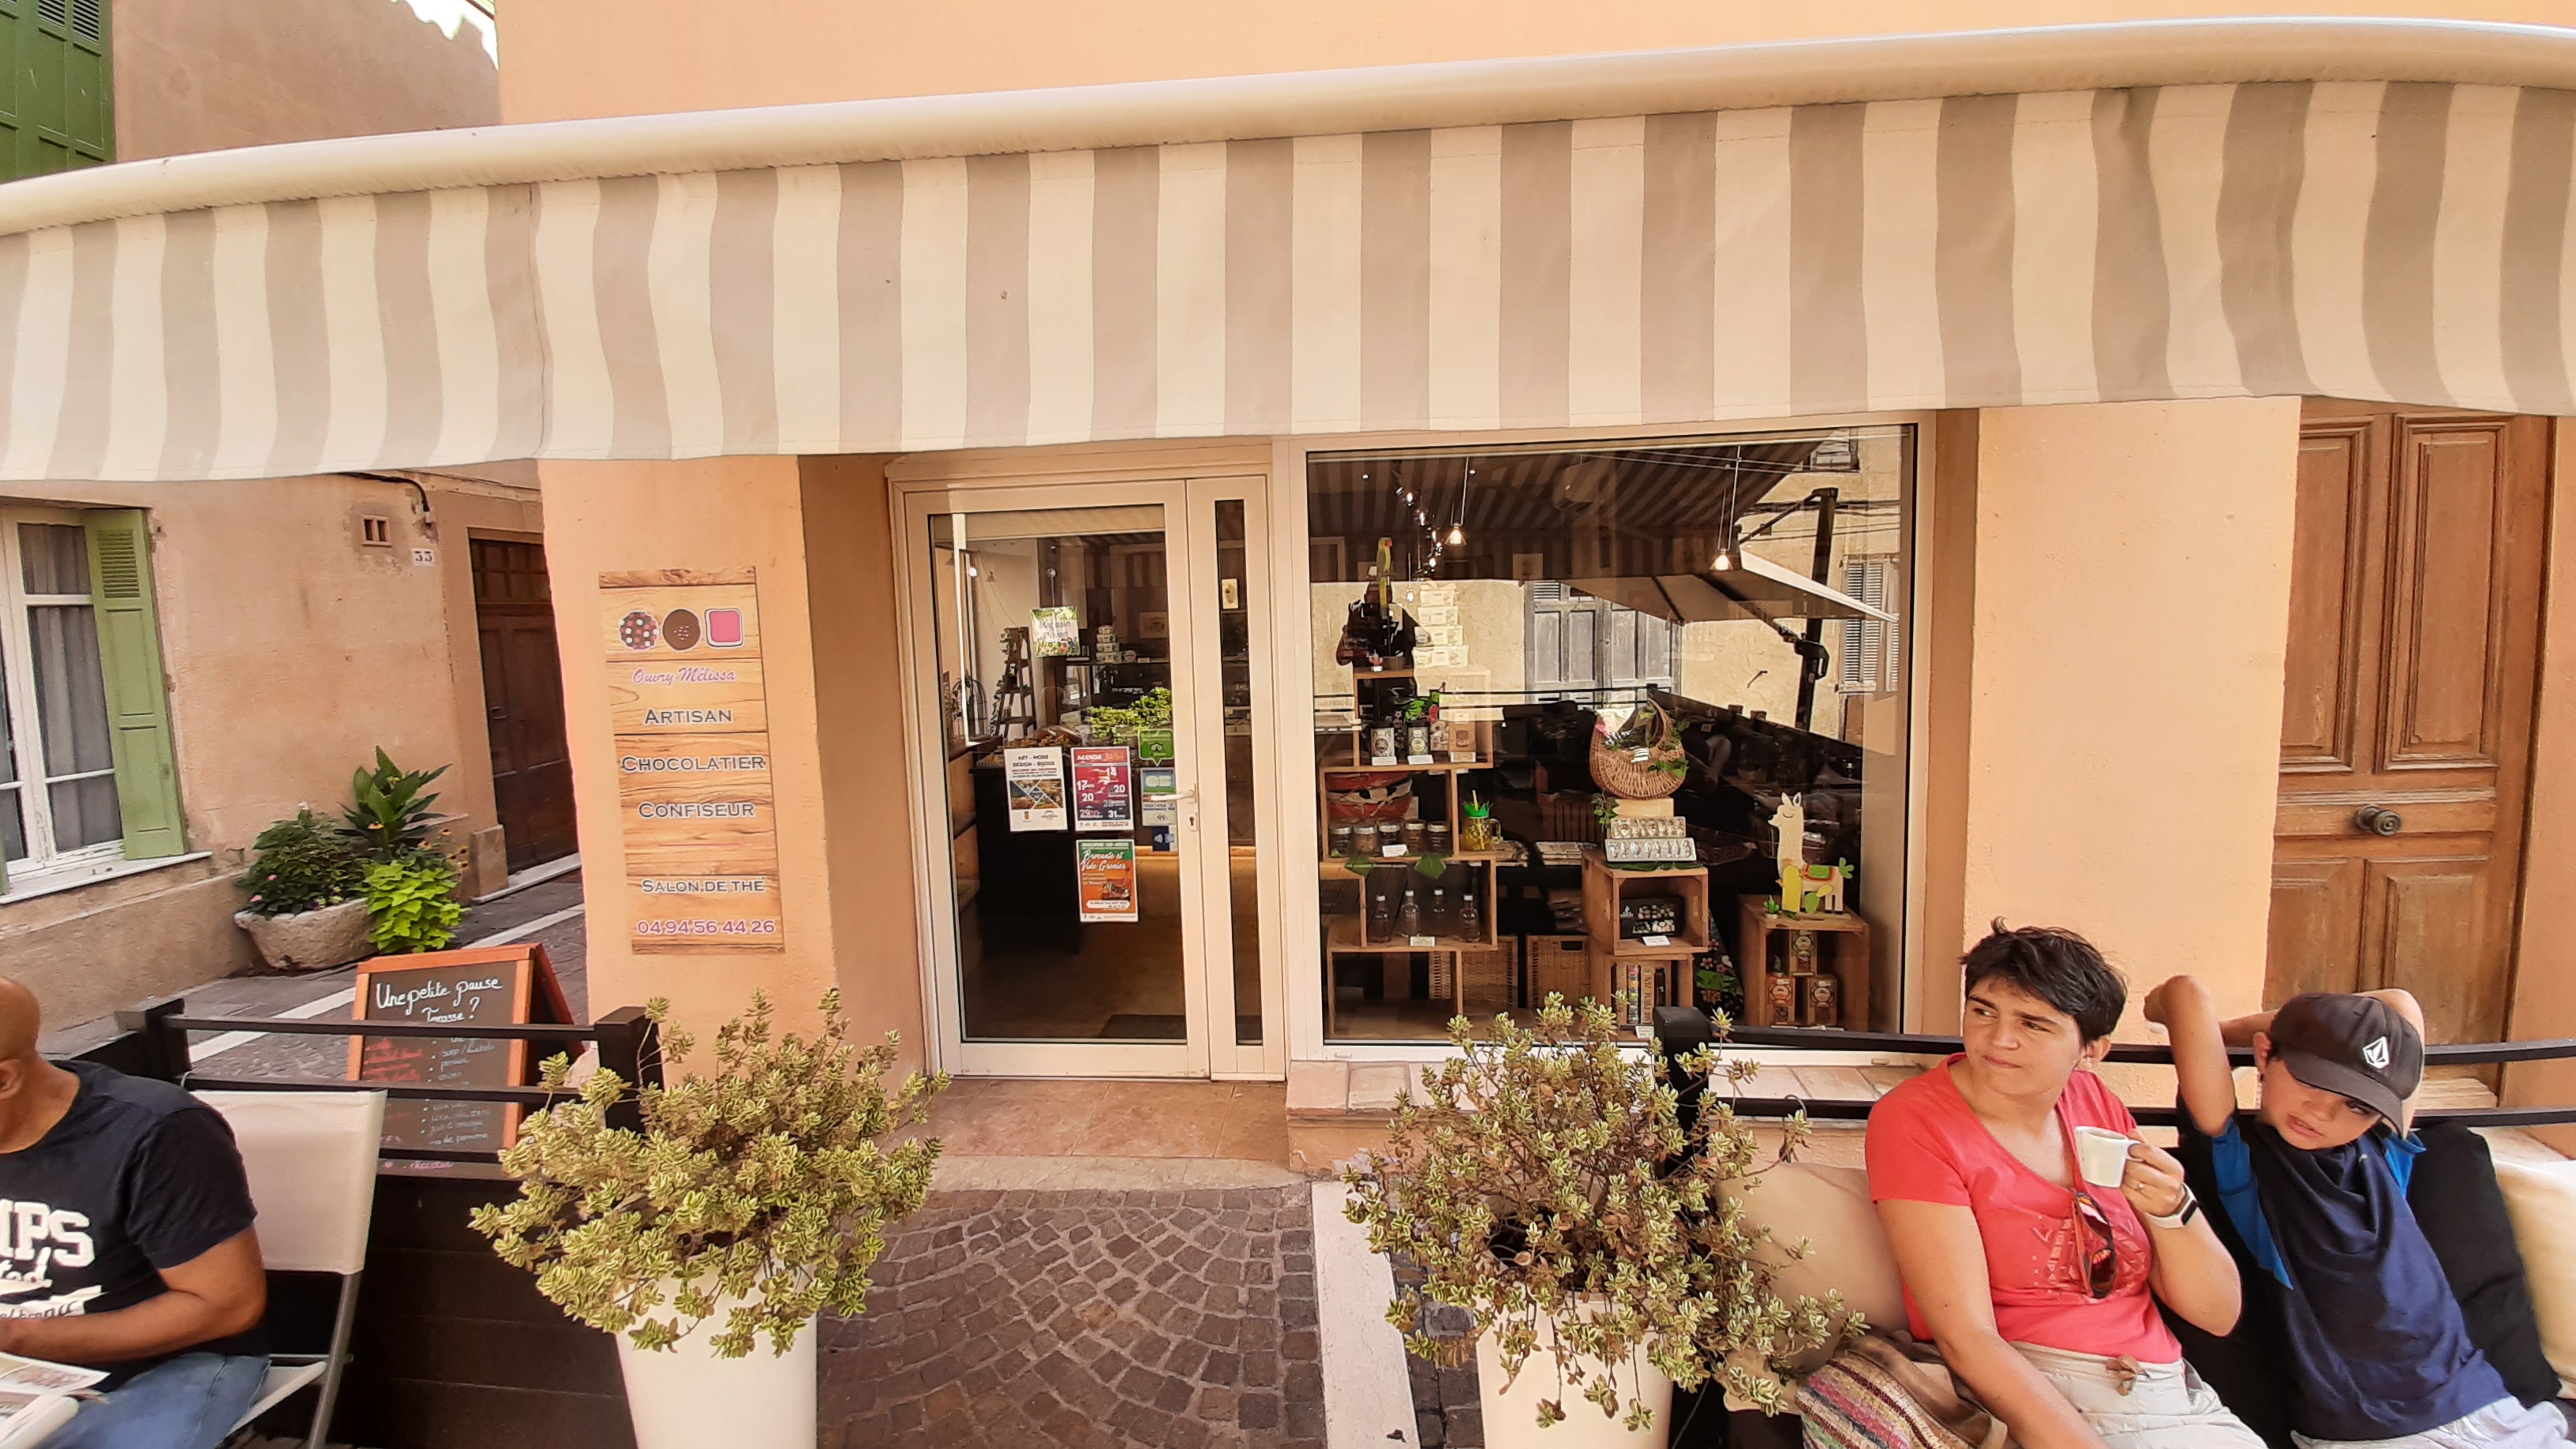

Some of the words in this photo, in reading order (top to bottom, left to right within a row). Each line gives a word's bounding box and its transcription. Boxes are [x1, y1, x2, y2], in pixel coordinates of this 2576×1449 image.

[678, 667, 736, 683] Mélissa
[644, 709, 732, 724] ARTISAN
[622, 755, 766, 772] CHOCOLATIER
[638, 803, 754, 818] CONFISEUR
[642, 880, 699, 892] SALON
[705, 881, 727, 892] DE
[638, 922, 661, 934] 04
[665, 922, 690, 934] 94
[694, 922, 717, 933] 56
[722, 921, 746, 933] 44
[751, 920, 775, 933] 26
[376, 983, 406, 1009] Une
[405, 980, 451, 1016] petite
[452, 978, 504, 1007] pause
[469, 996, 481, 1019] ?
